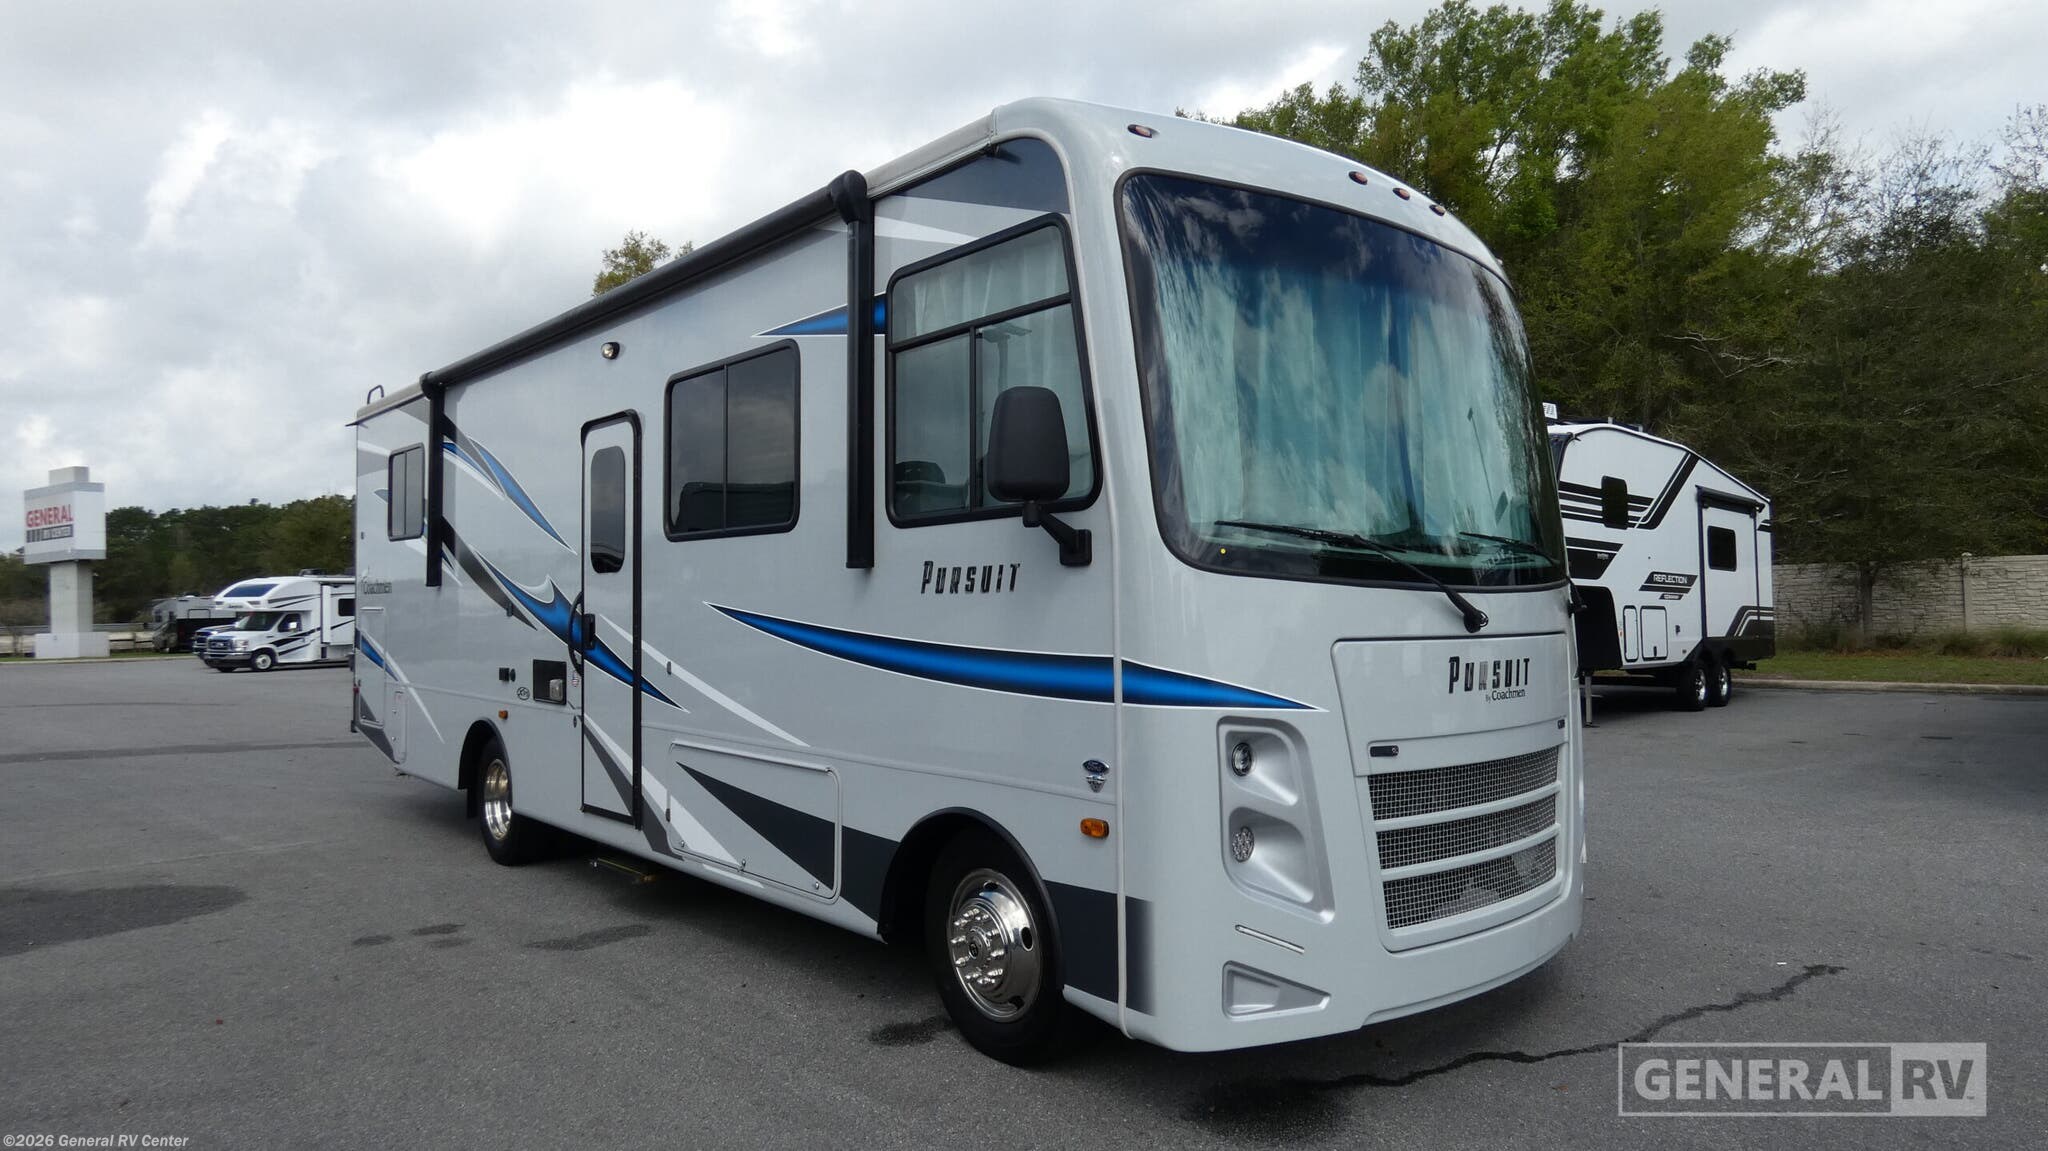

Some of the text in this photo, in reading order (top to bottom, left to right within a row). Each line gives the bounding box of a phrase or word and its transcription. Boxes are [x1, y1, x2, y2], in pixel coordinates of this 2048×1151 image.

[26, 504, 74, 528] GENERAL
[920, 560, 1021, 594] PURSUIT
[1653, 574, 1688, 584] REFLECTION
[1448, 656, 1530, 694] PURSUIT
[1491, 688, 1526, 701] Coachmen
